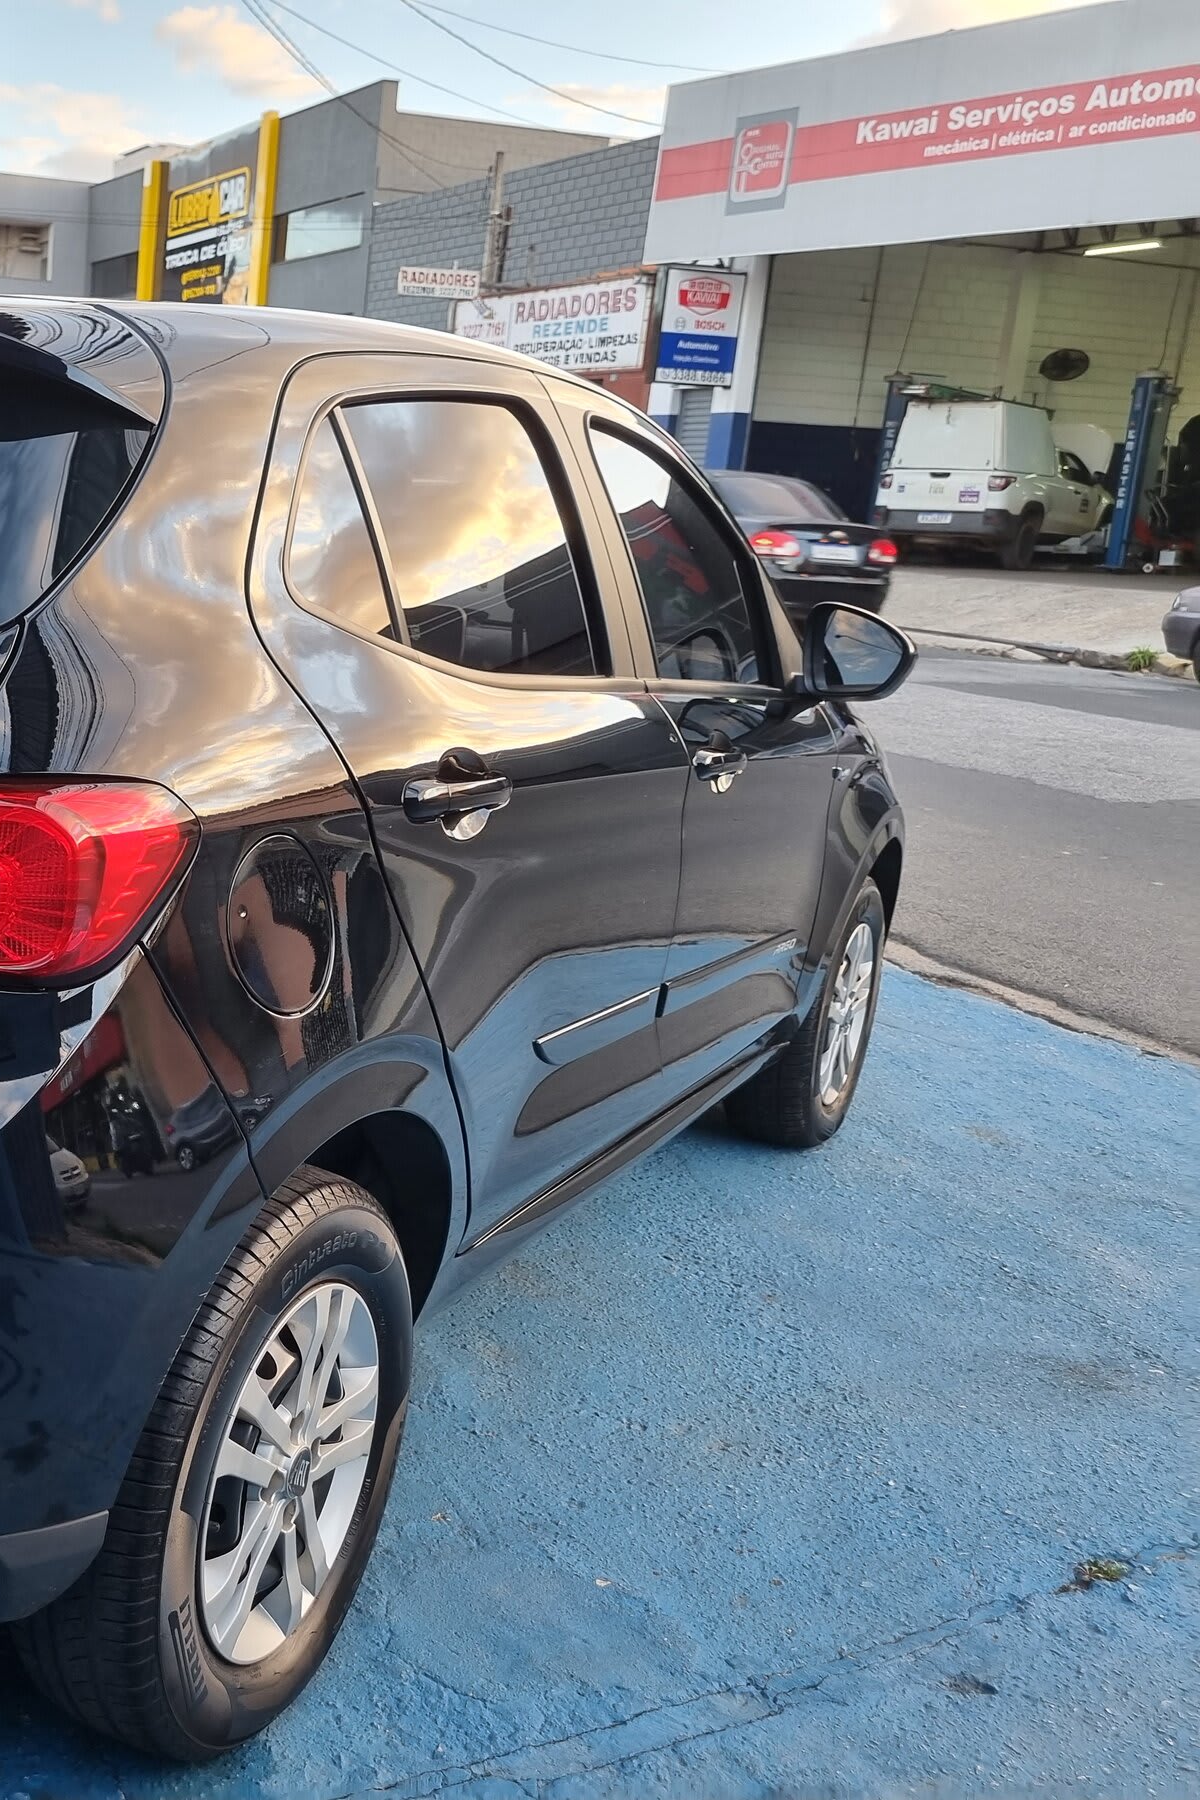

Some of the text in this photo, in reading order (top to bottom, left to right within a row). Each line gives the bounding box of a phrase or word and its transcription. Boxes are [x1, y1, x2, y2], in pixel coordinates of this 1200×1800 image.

[856, 76, 1200, 145] Kawai Serviços Autom
[924, 109, 1196, 157] mecânica elétrica ar condicionado
[165, 249, 199, 270] TROCA
[200, 244, 217, 261] DE
[400, 270, 477, 288] RADIADORES
[515, 287, 637, 324] RADIADORES
[687, 290, 721, 304] KAWAI
[532, 317, 609, 338] REZENDE
[694, 320, 726, 331] BOSCH
[588, 332, 638, 349] LIMPEZAS
[564, 354, 571, 365] E
[572, 350, 617, 365] VENDAS
[282, 1231, 358, 1299] Cinturato
[168, 1594, 209, 1703] PIRELLI
